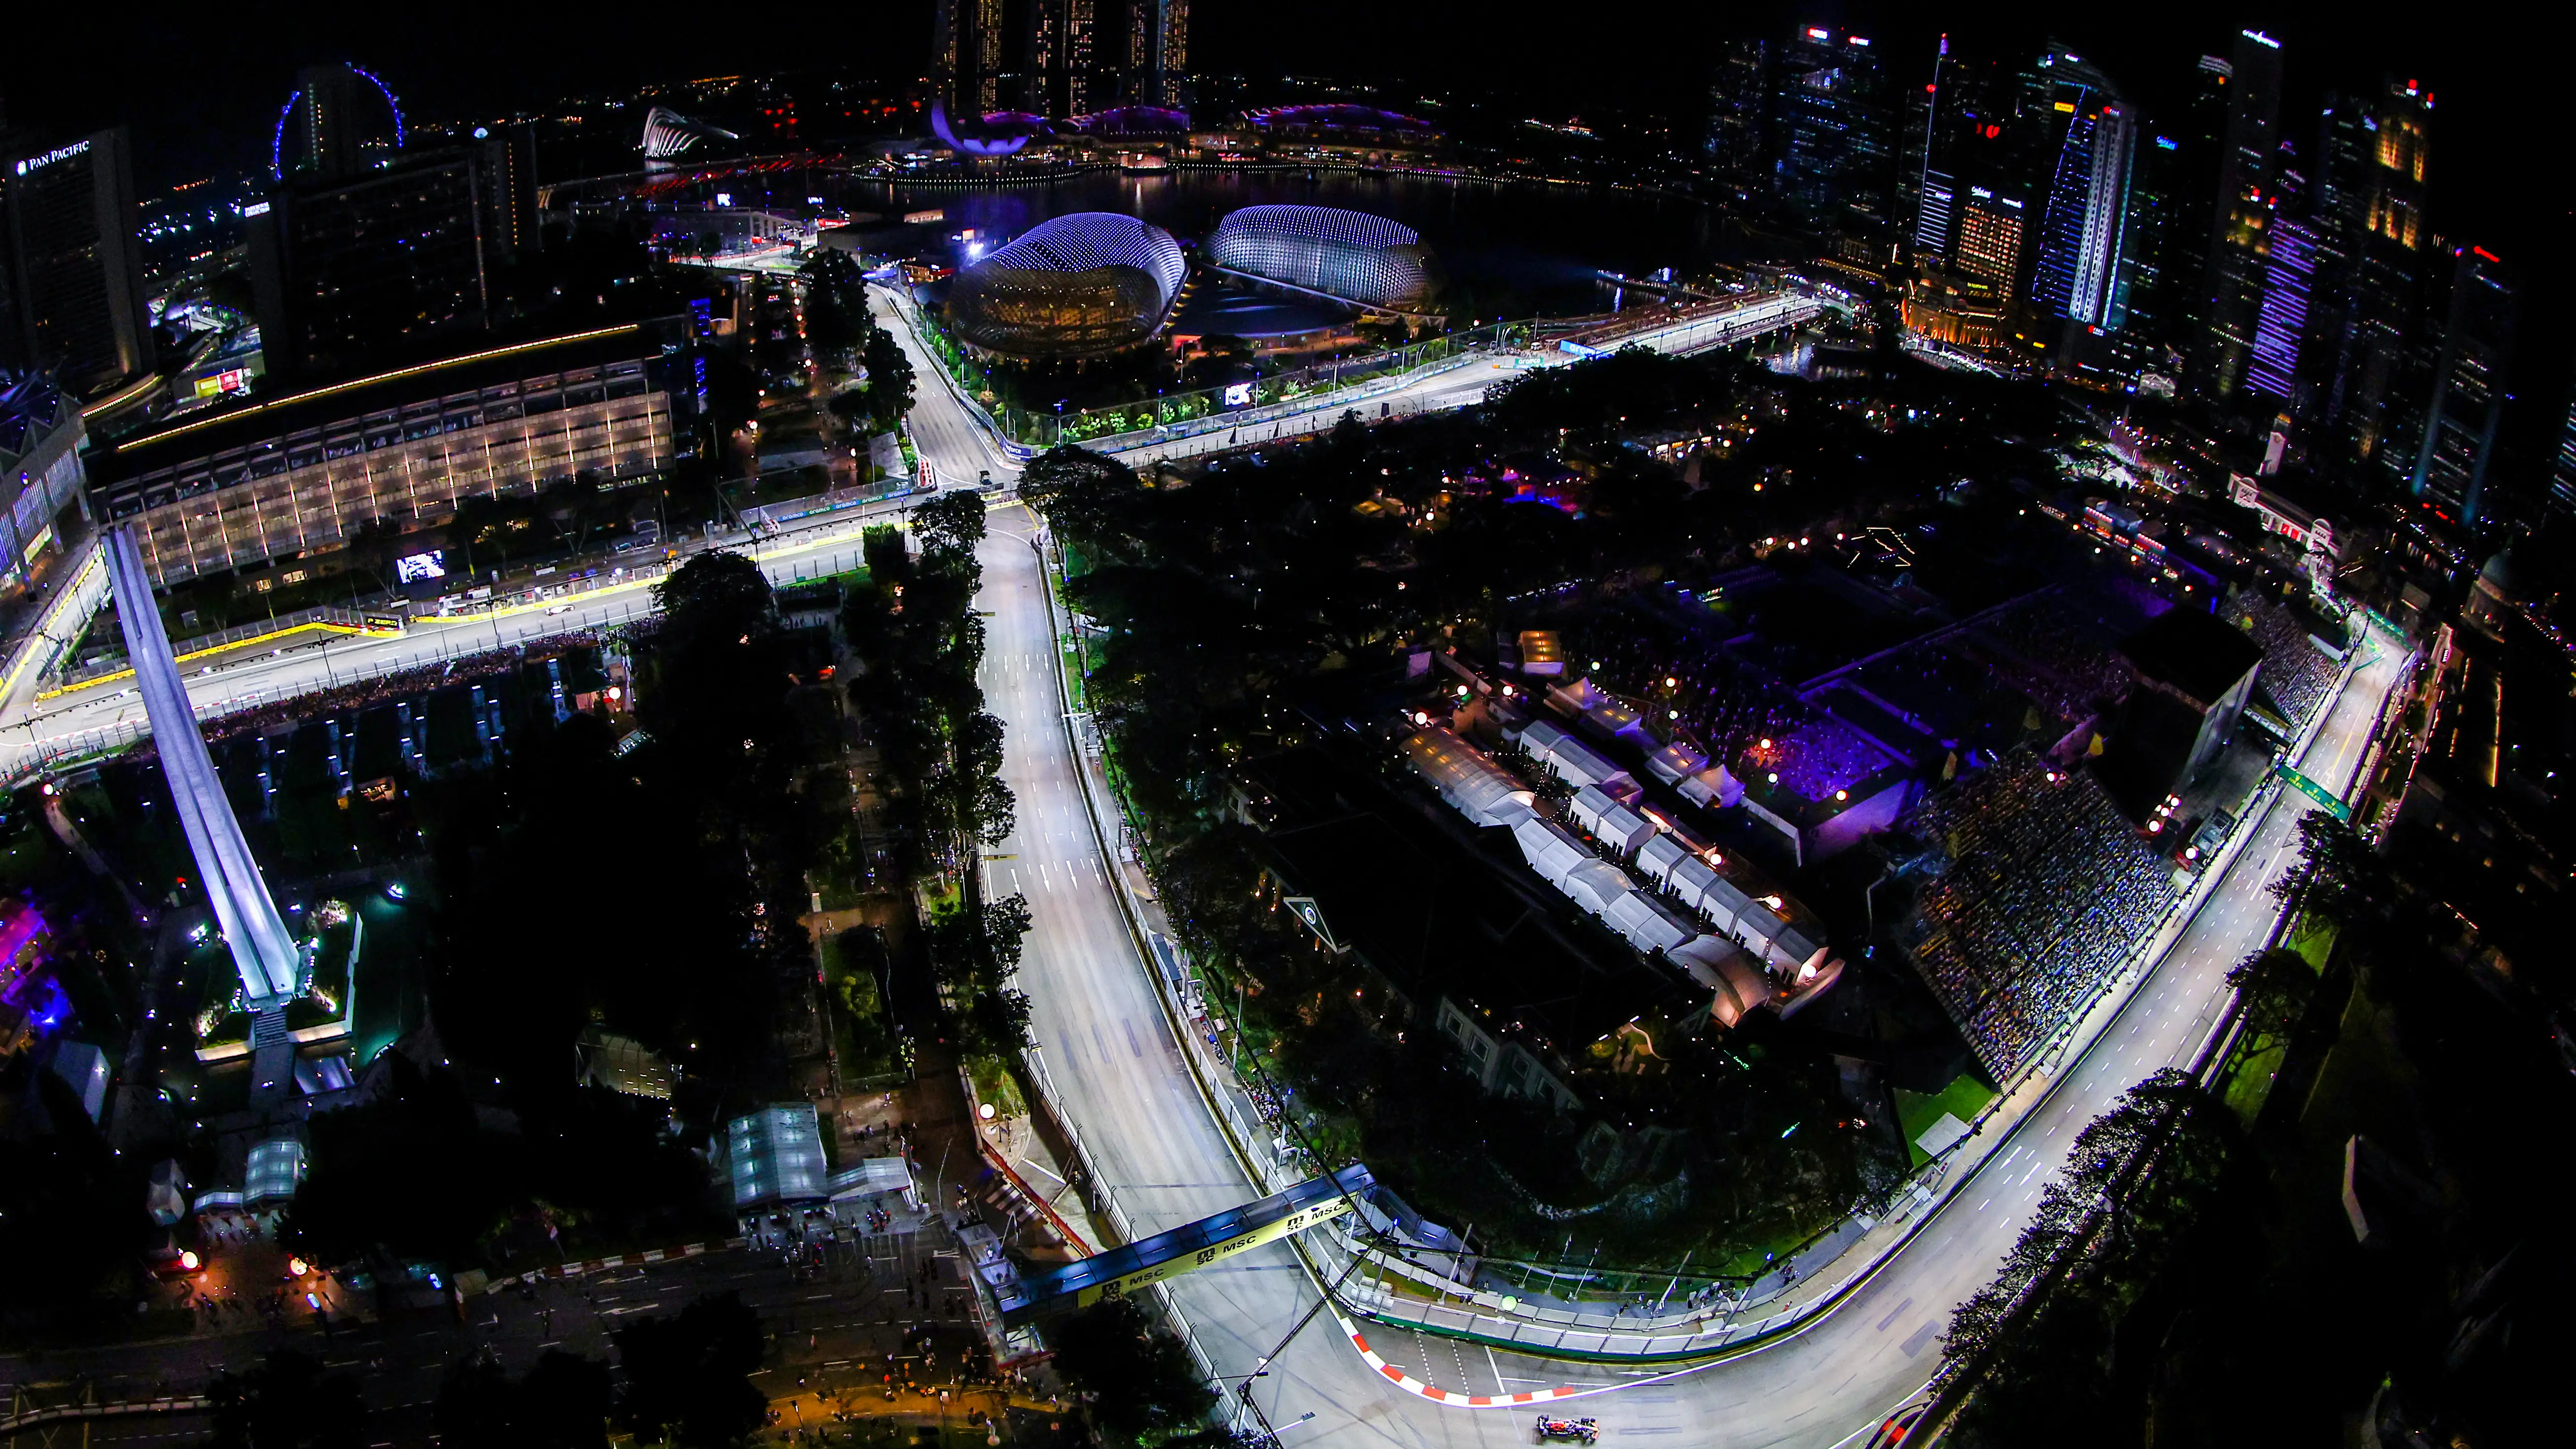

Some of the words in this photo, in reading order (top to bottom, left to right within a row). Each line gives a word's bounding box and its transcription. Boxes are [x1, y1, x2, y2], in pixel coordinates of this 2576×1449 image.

[29, 154, 48, 170] PAN
[50, 141, 89, 162] PACIFIC
[782, 512, 803, 520] aramco
[809, 506, 830, 515] aramco
[835, 500, 857, 509] aramco
[862, 494, 882, 503] aramco
[888, 489, 908, 498] aramco
[2288, 777, 2303, 789] ROLEX
[2306, 790, 2321, 801] ROLEX
[2324, 802, 2339, 814] ROLEX
[1312, 1204, 1342, 1220] MSC
[1223, 1235, 1256, 1253] MSC
[1129, 1268, 1165, 1286] MSC
